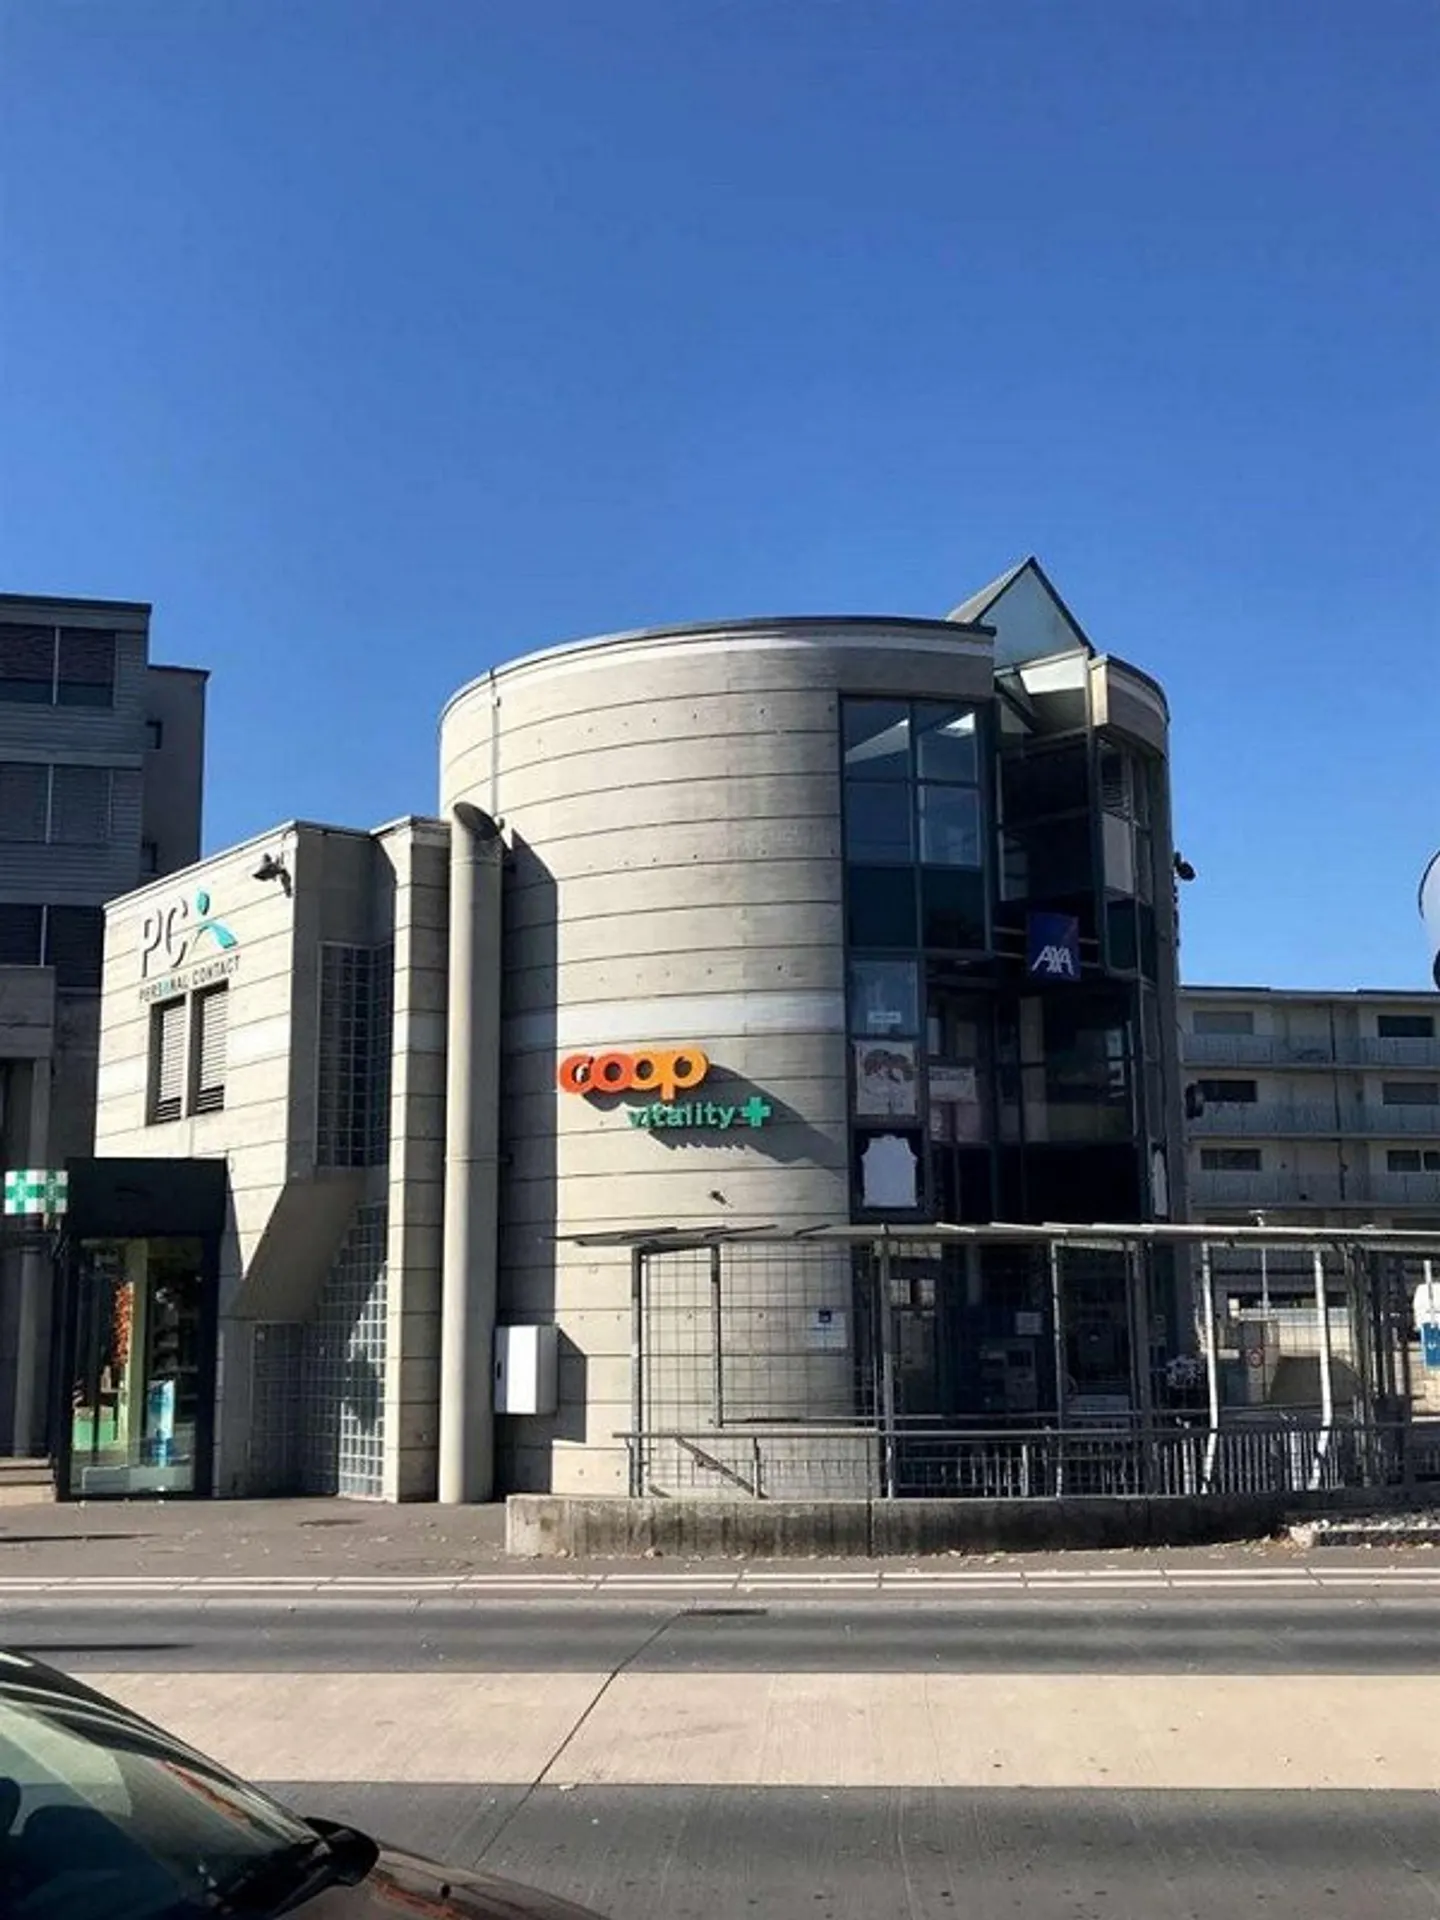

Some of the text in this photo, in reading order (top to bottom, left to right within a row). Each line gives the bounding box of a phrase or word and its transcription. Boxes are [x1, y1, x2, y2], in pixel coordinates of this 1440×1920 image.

[140, 896, 188, 978] PC
[192, 955, 241, 986] CONTACT
[1031, 944, 1075, 977] AXA
[559, 1049, 709, 1103] coop
[629, 1099, 735, 1129] vitality
